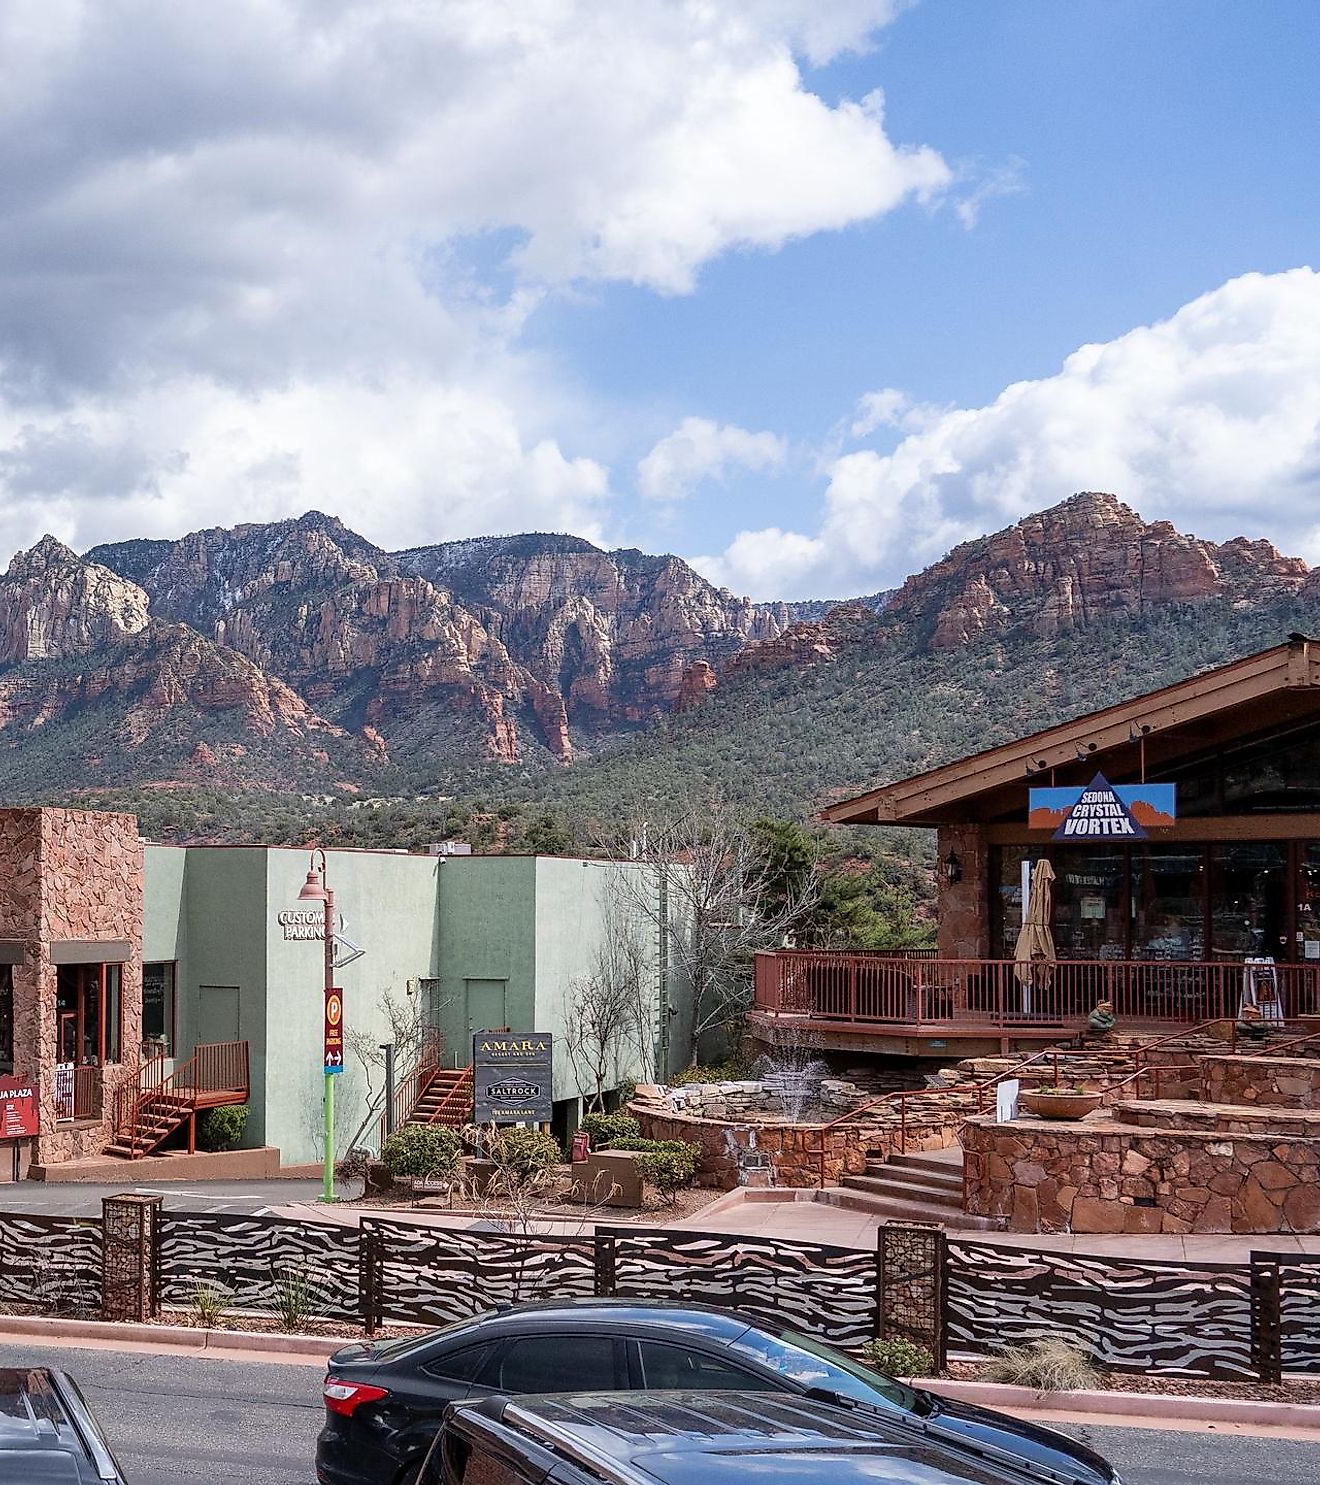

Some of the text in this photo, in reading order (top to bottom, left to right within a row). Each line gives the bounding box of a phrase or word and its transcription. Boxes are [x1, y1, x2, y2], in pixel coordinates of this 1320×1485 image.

[1081, 791, 1116, 803] SEDONA
[1072, 804, 1125, 817] CRYSTAL
[1064, 818, 1135, 835] VORTEX
[331, 1002, 338, 1019] P
[481, 1041, 547, 1051] AMARA
[10, 1088, 33, 1098] PLAZA
[491, 1087, 536, 1096] SALTROCK
